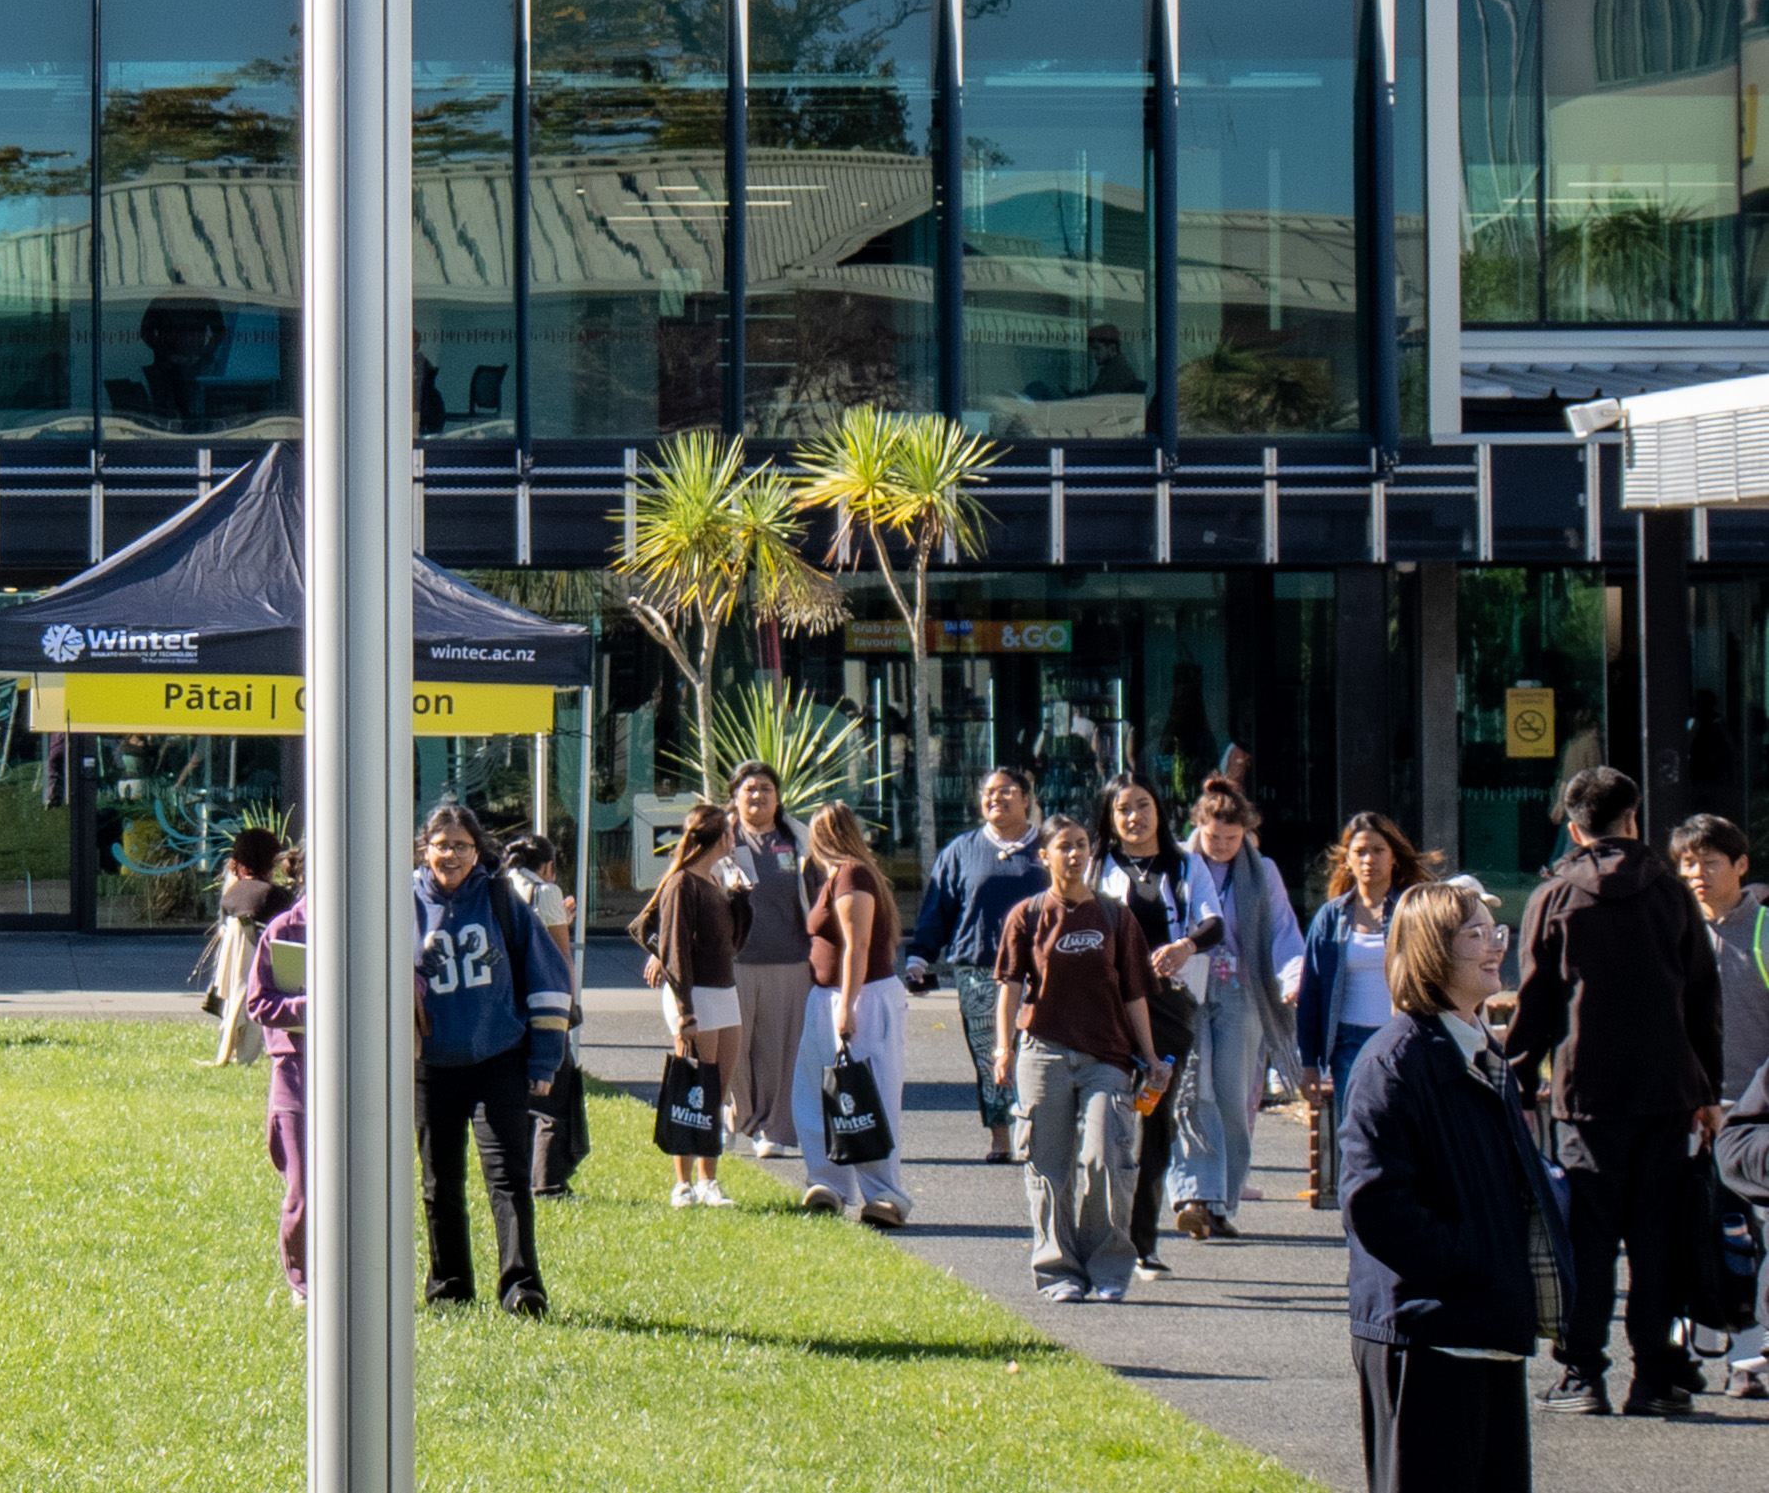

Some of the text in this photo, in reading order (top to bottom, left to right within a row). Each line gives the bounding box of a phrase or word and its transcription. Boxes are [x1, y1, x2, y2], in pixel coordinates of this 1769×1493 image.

[851, 622, 881, 634] Grab
[1002, 624, 1068, 648] &GO
[86, 629, 200, 650] Wintec
[431, 644, 536, 662] wintec.ac.nz
[164, 682, 252, 710] Pātai
[671, 1104, 713, 1127] Wintec
[833, 1112, 876, 1130] Wntec
